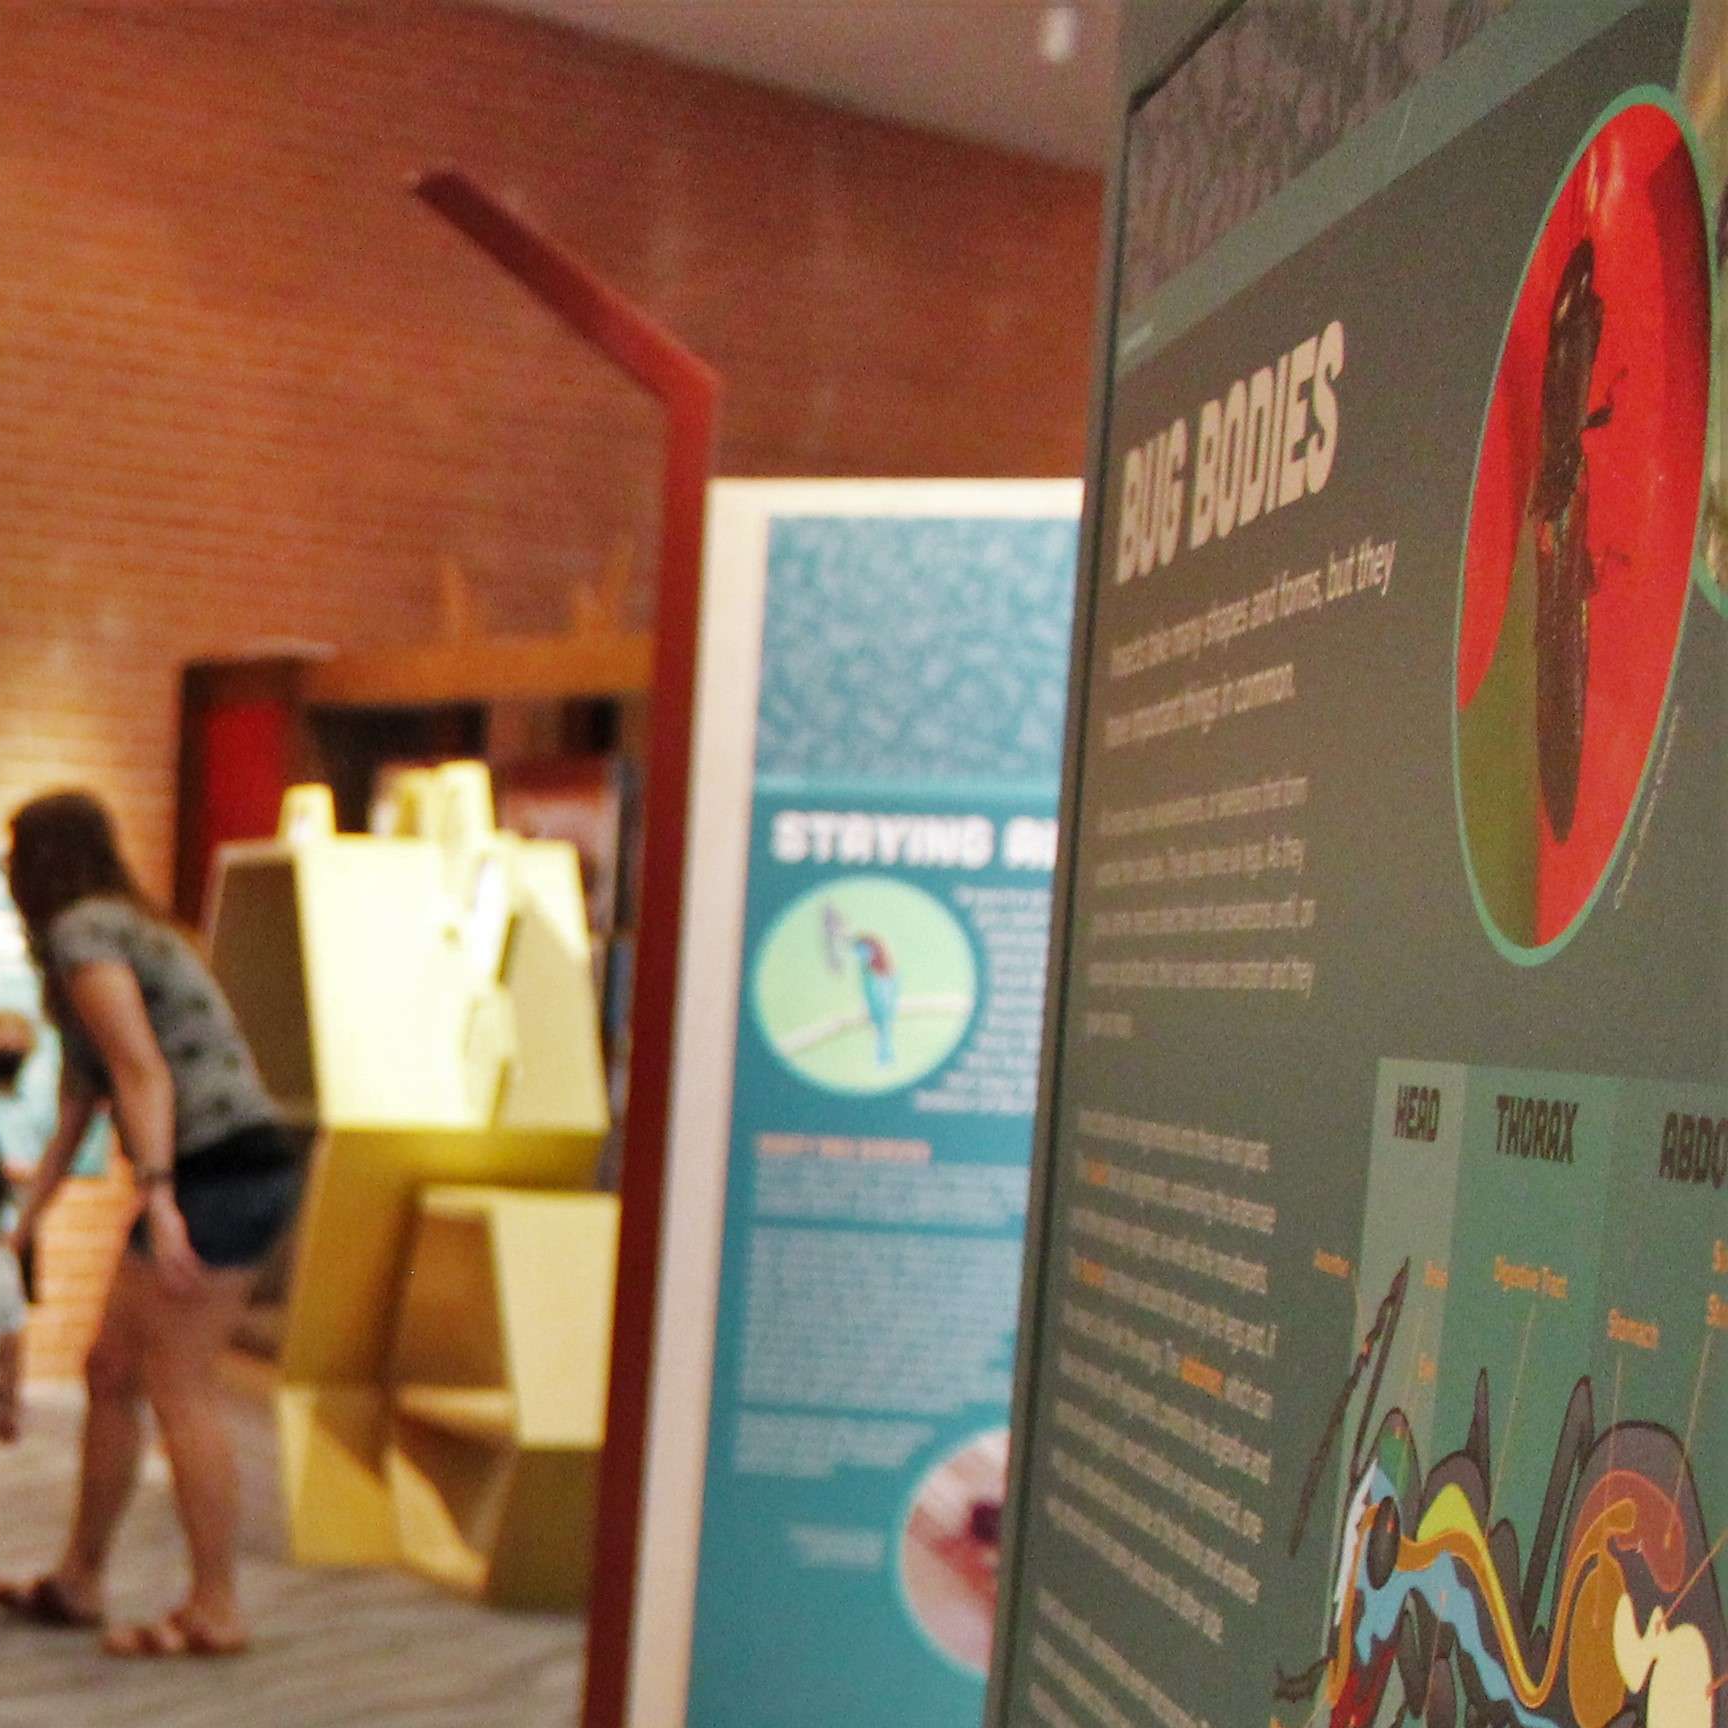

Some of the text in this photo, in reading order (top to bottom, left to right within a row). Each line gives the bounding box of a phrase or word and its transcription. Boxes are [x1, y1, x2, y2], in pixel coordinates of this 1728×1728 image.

[1116, 319, 1344, 587] BUG BODIES
[1326, 551, 1356, 601] but
[1356, 536, 1396, 597] they
[772, 810, 995, 872] STAYING
[1393, 1085, 1441, 1143] HEAD
[1495, 1093, 1580, 1165] THORAX
